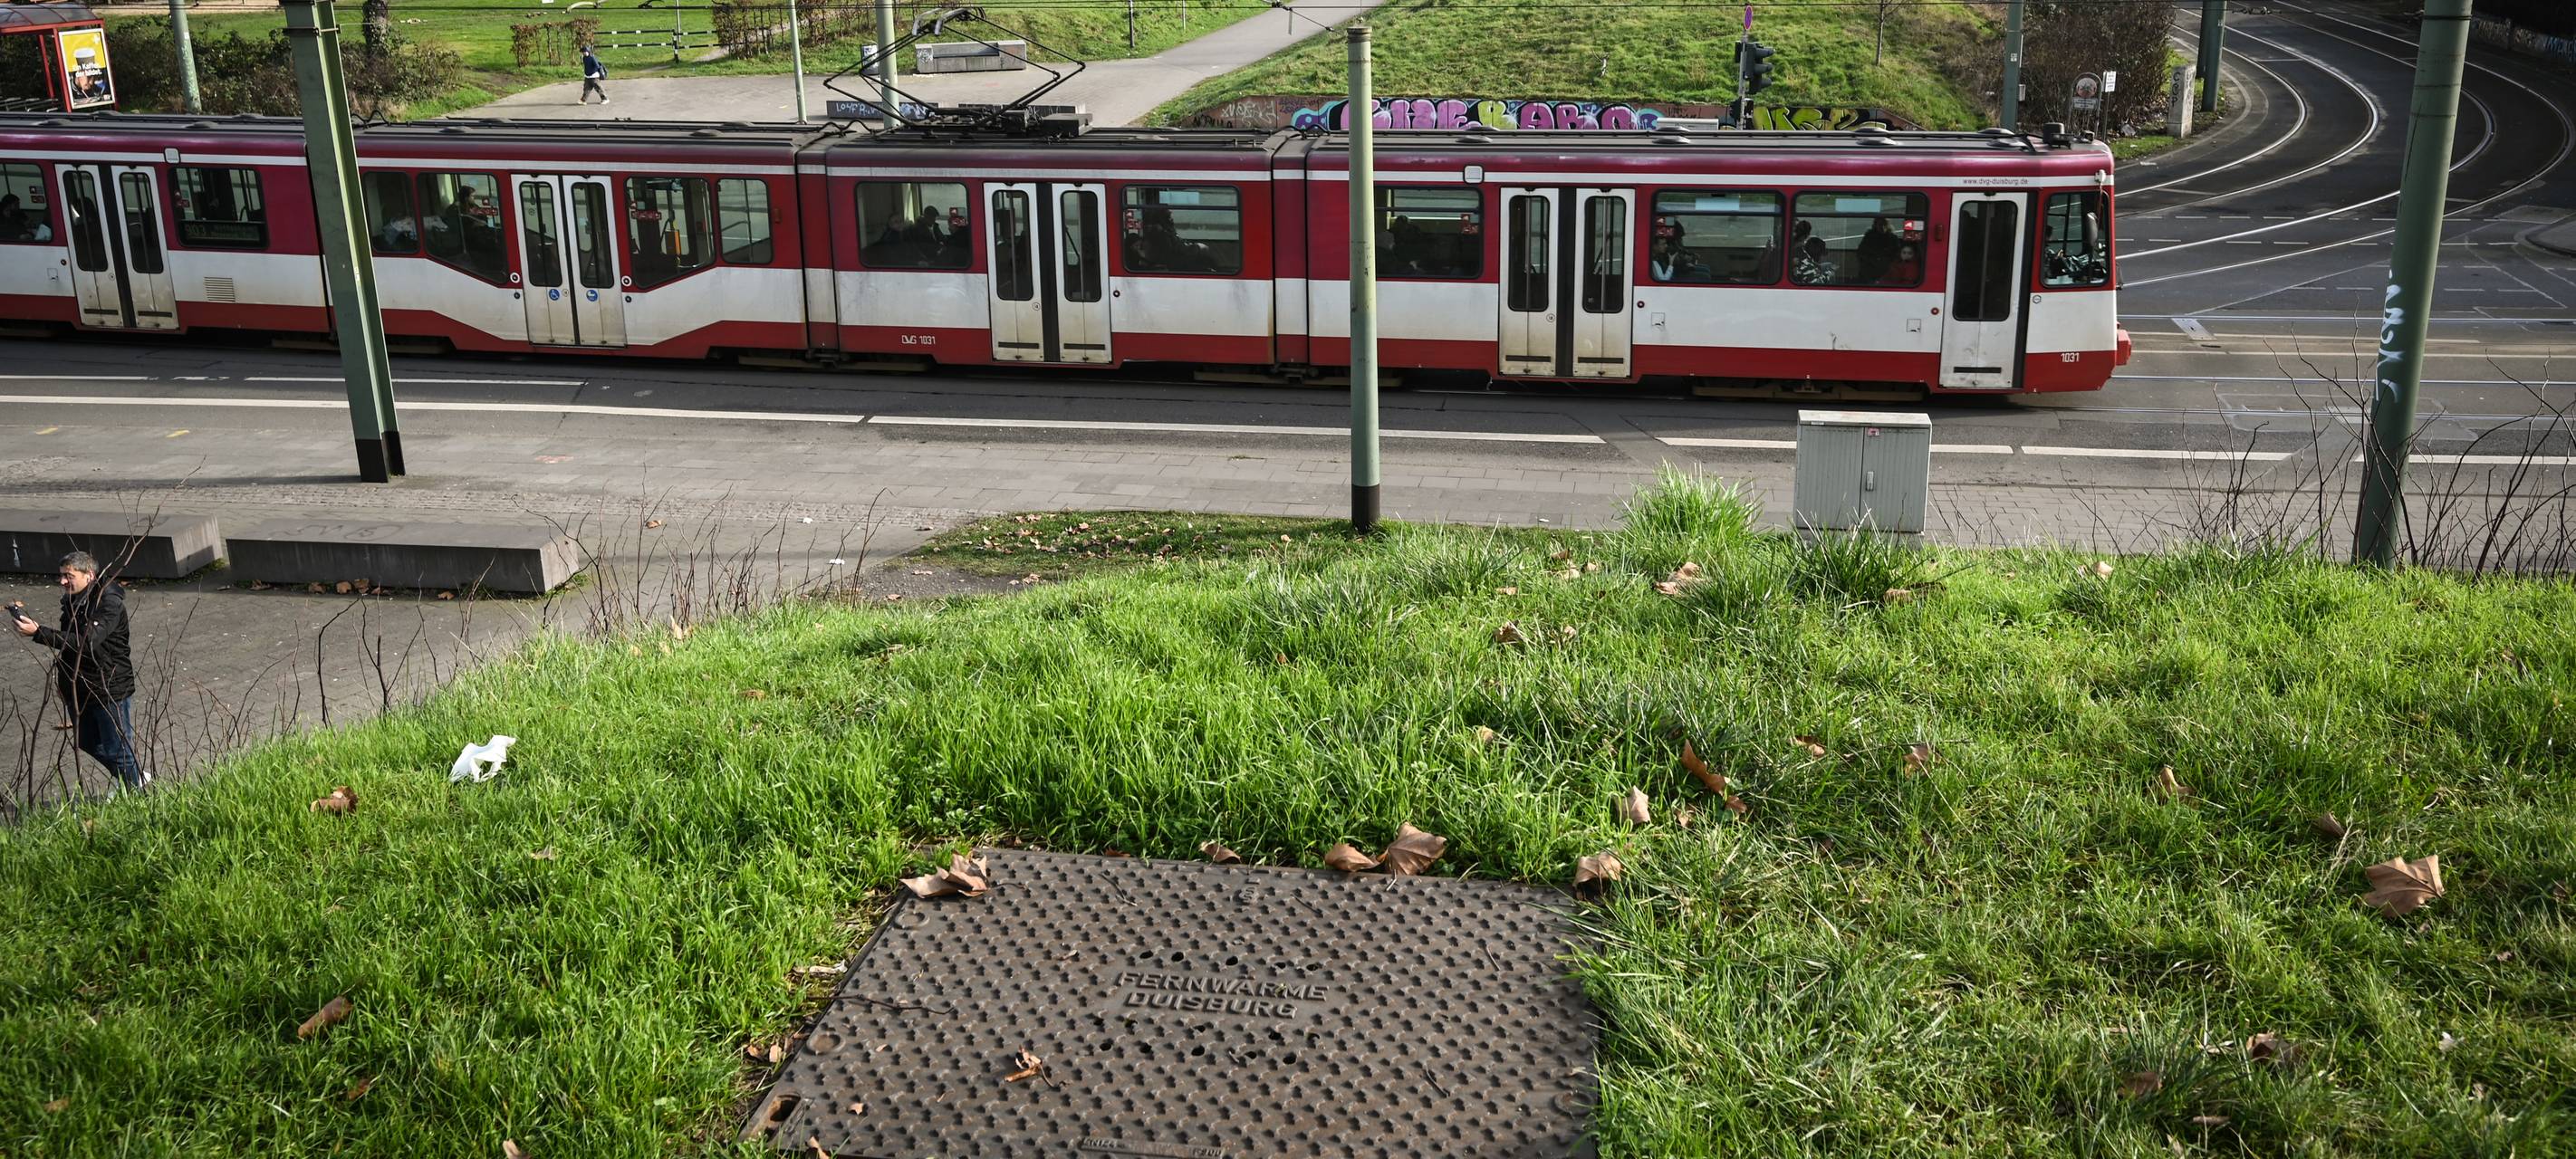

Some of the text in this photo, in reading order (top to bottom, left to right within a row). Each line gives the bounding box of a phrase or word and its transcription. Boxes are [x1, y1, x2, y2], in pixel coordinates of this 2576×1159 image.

[1962, 177, 2028, 187] www.dvg-duisburg.de
[918, 335, 936, 345] 1031
[2060, 352, 2080, 363] 1031
[1115, 971, 1329, 1001] FERNWÄRME
[1124, 992, 1298, 1020] DUISBURG
